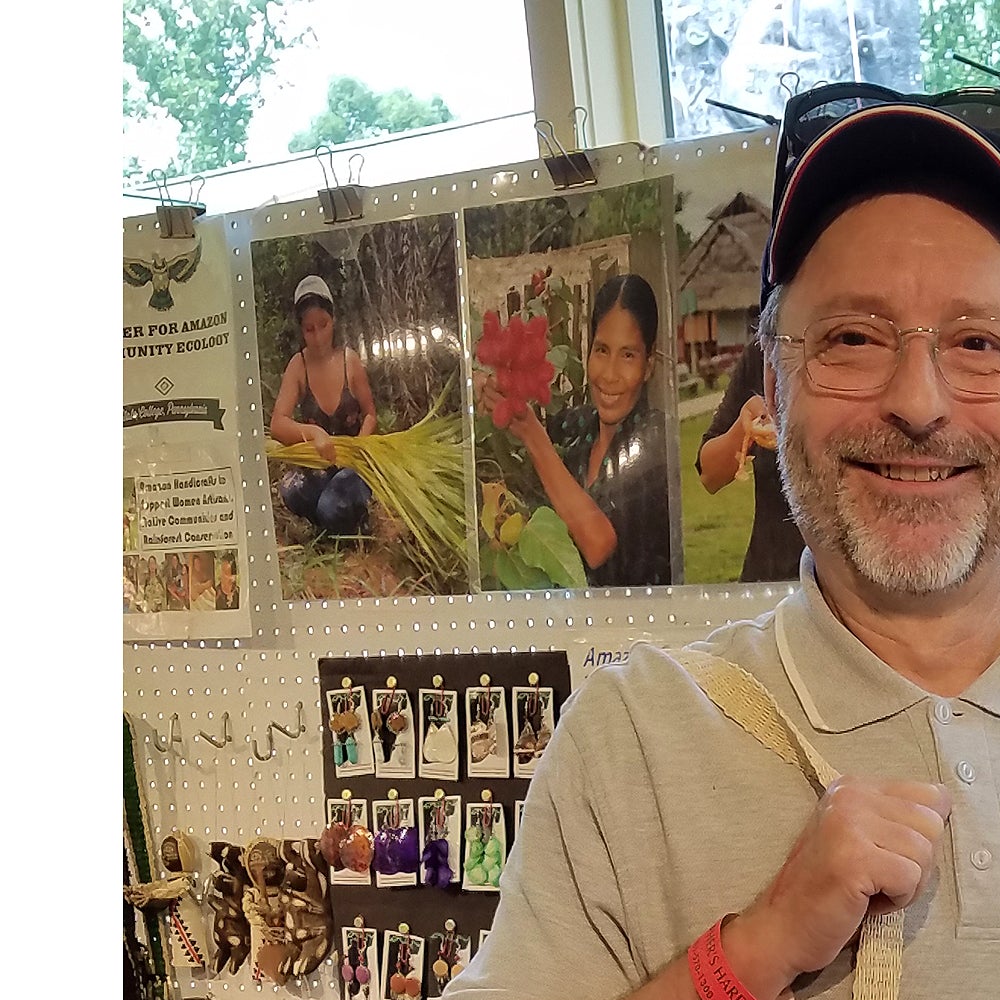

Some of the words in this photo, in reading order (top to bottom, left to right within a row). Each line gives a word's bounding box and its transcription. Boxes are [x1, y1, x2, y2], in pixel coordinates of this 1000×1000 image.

[148, 322, 178, 336] FOR
[181, 311, 228, 333] AMAZON
[123, 343, 173, 358] UNITY
[176, 333, 230, 353] ECOLOGY
[218, 475, 226, 485] to
[172, 496, 201, 507] Women
[219, 510, 234, 521] and
[143, 532, 182, 544] Rainforest
